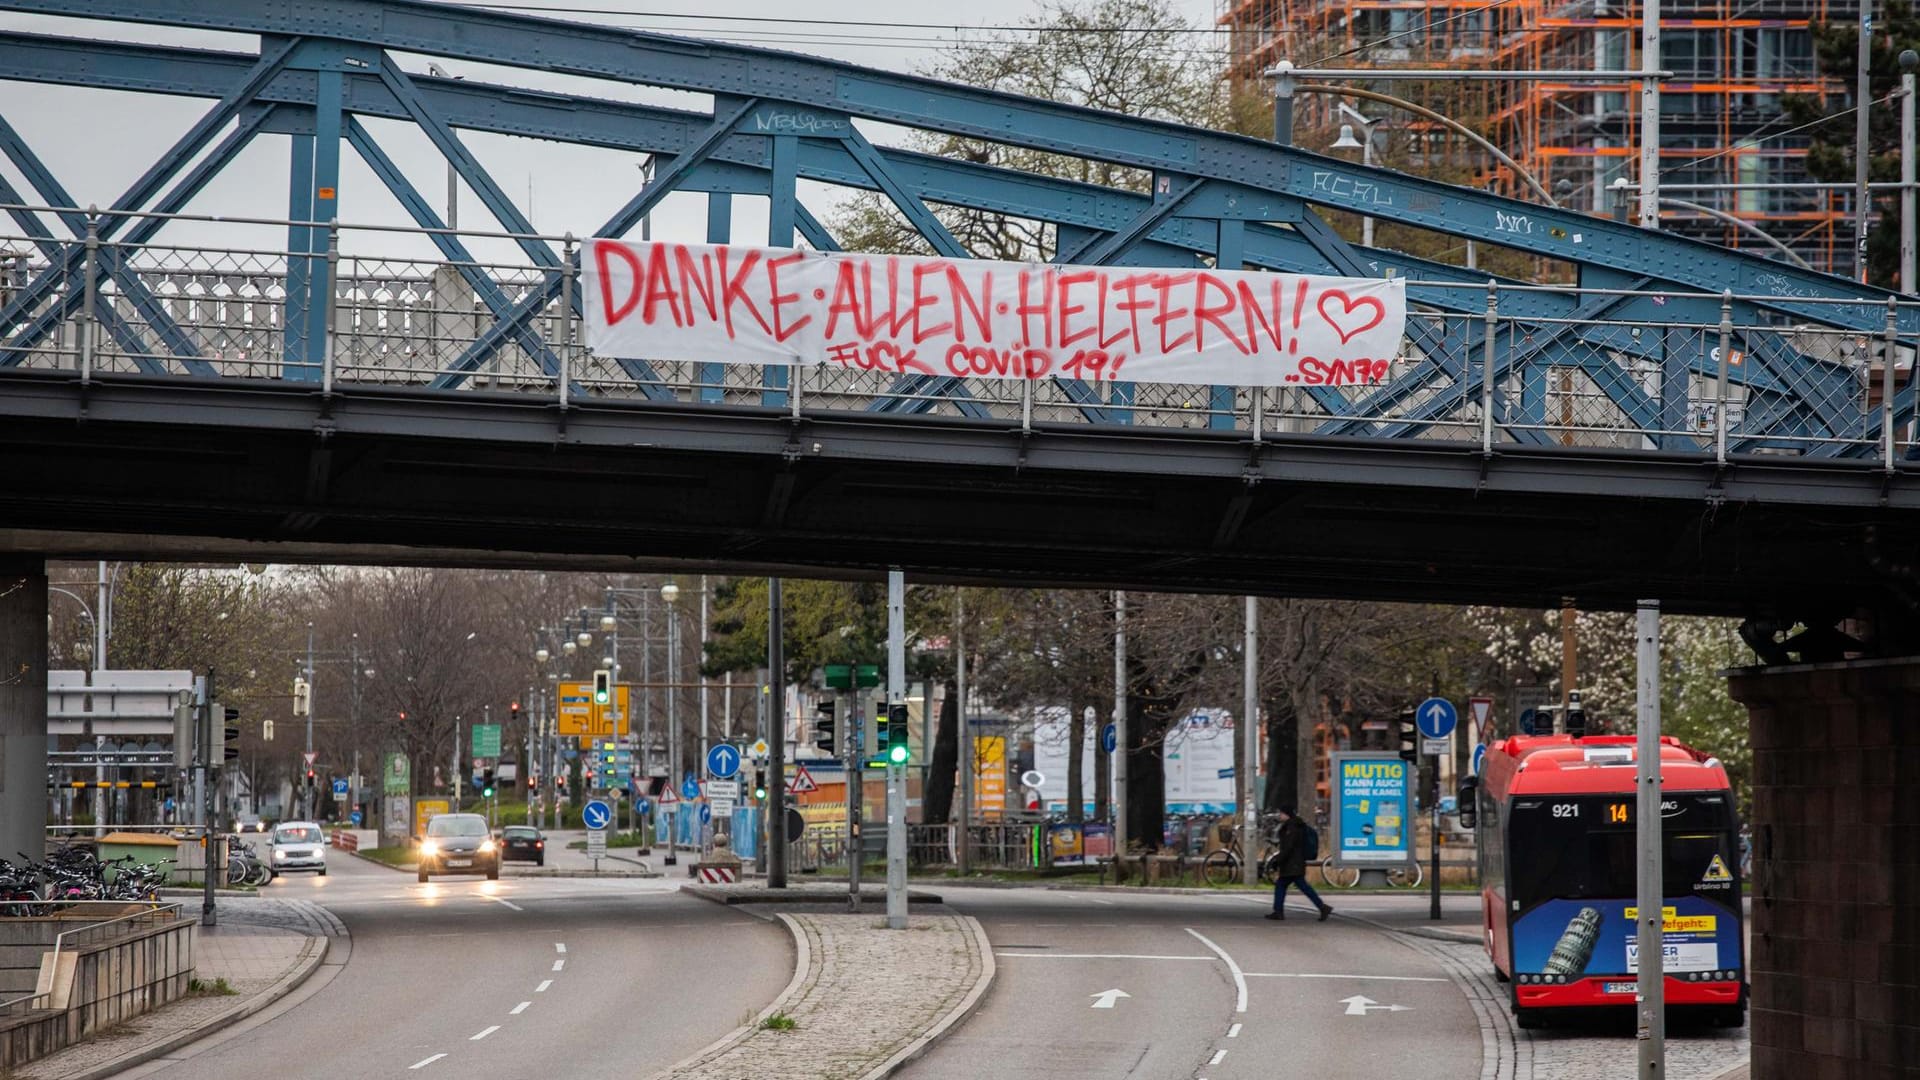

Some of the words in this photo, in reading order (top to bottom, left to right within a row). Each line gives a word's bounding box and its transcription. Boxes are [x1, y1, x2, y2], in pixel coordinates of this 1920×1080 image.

[594, 239, 812, 343] DANKE
[824, 256, 992, 344] ALLEN
[1016, 270, 1310, 356] HELFERN!
[827, 341, 938, 376] FUCK
[1062, 350, 1126, 382] 19!
[1344, 764, 1403, 778] MUTIG
[1344, 779, 1374, 787] KANN
[1375, 779, 1403, 787] AUCH
[1344, 788, 1371, 796] OHNE
[1552, 804, 1579, 817] 921
[1610, 804, 1627, 822] 14
